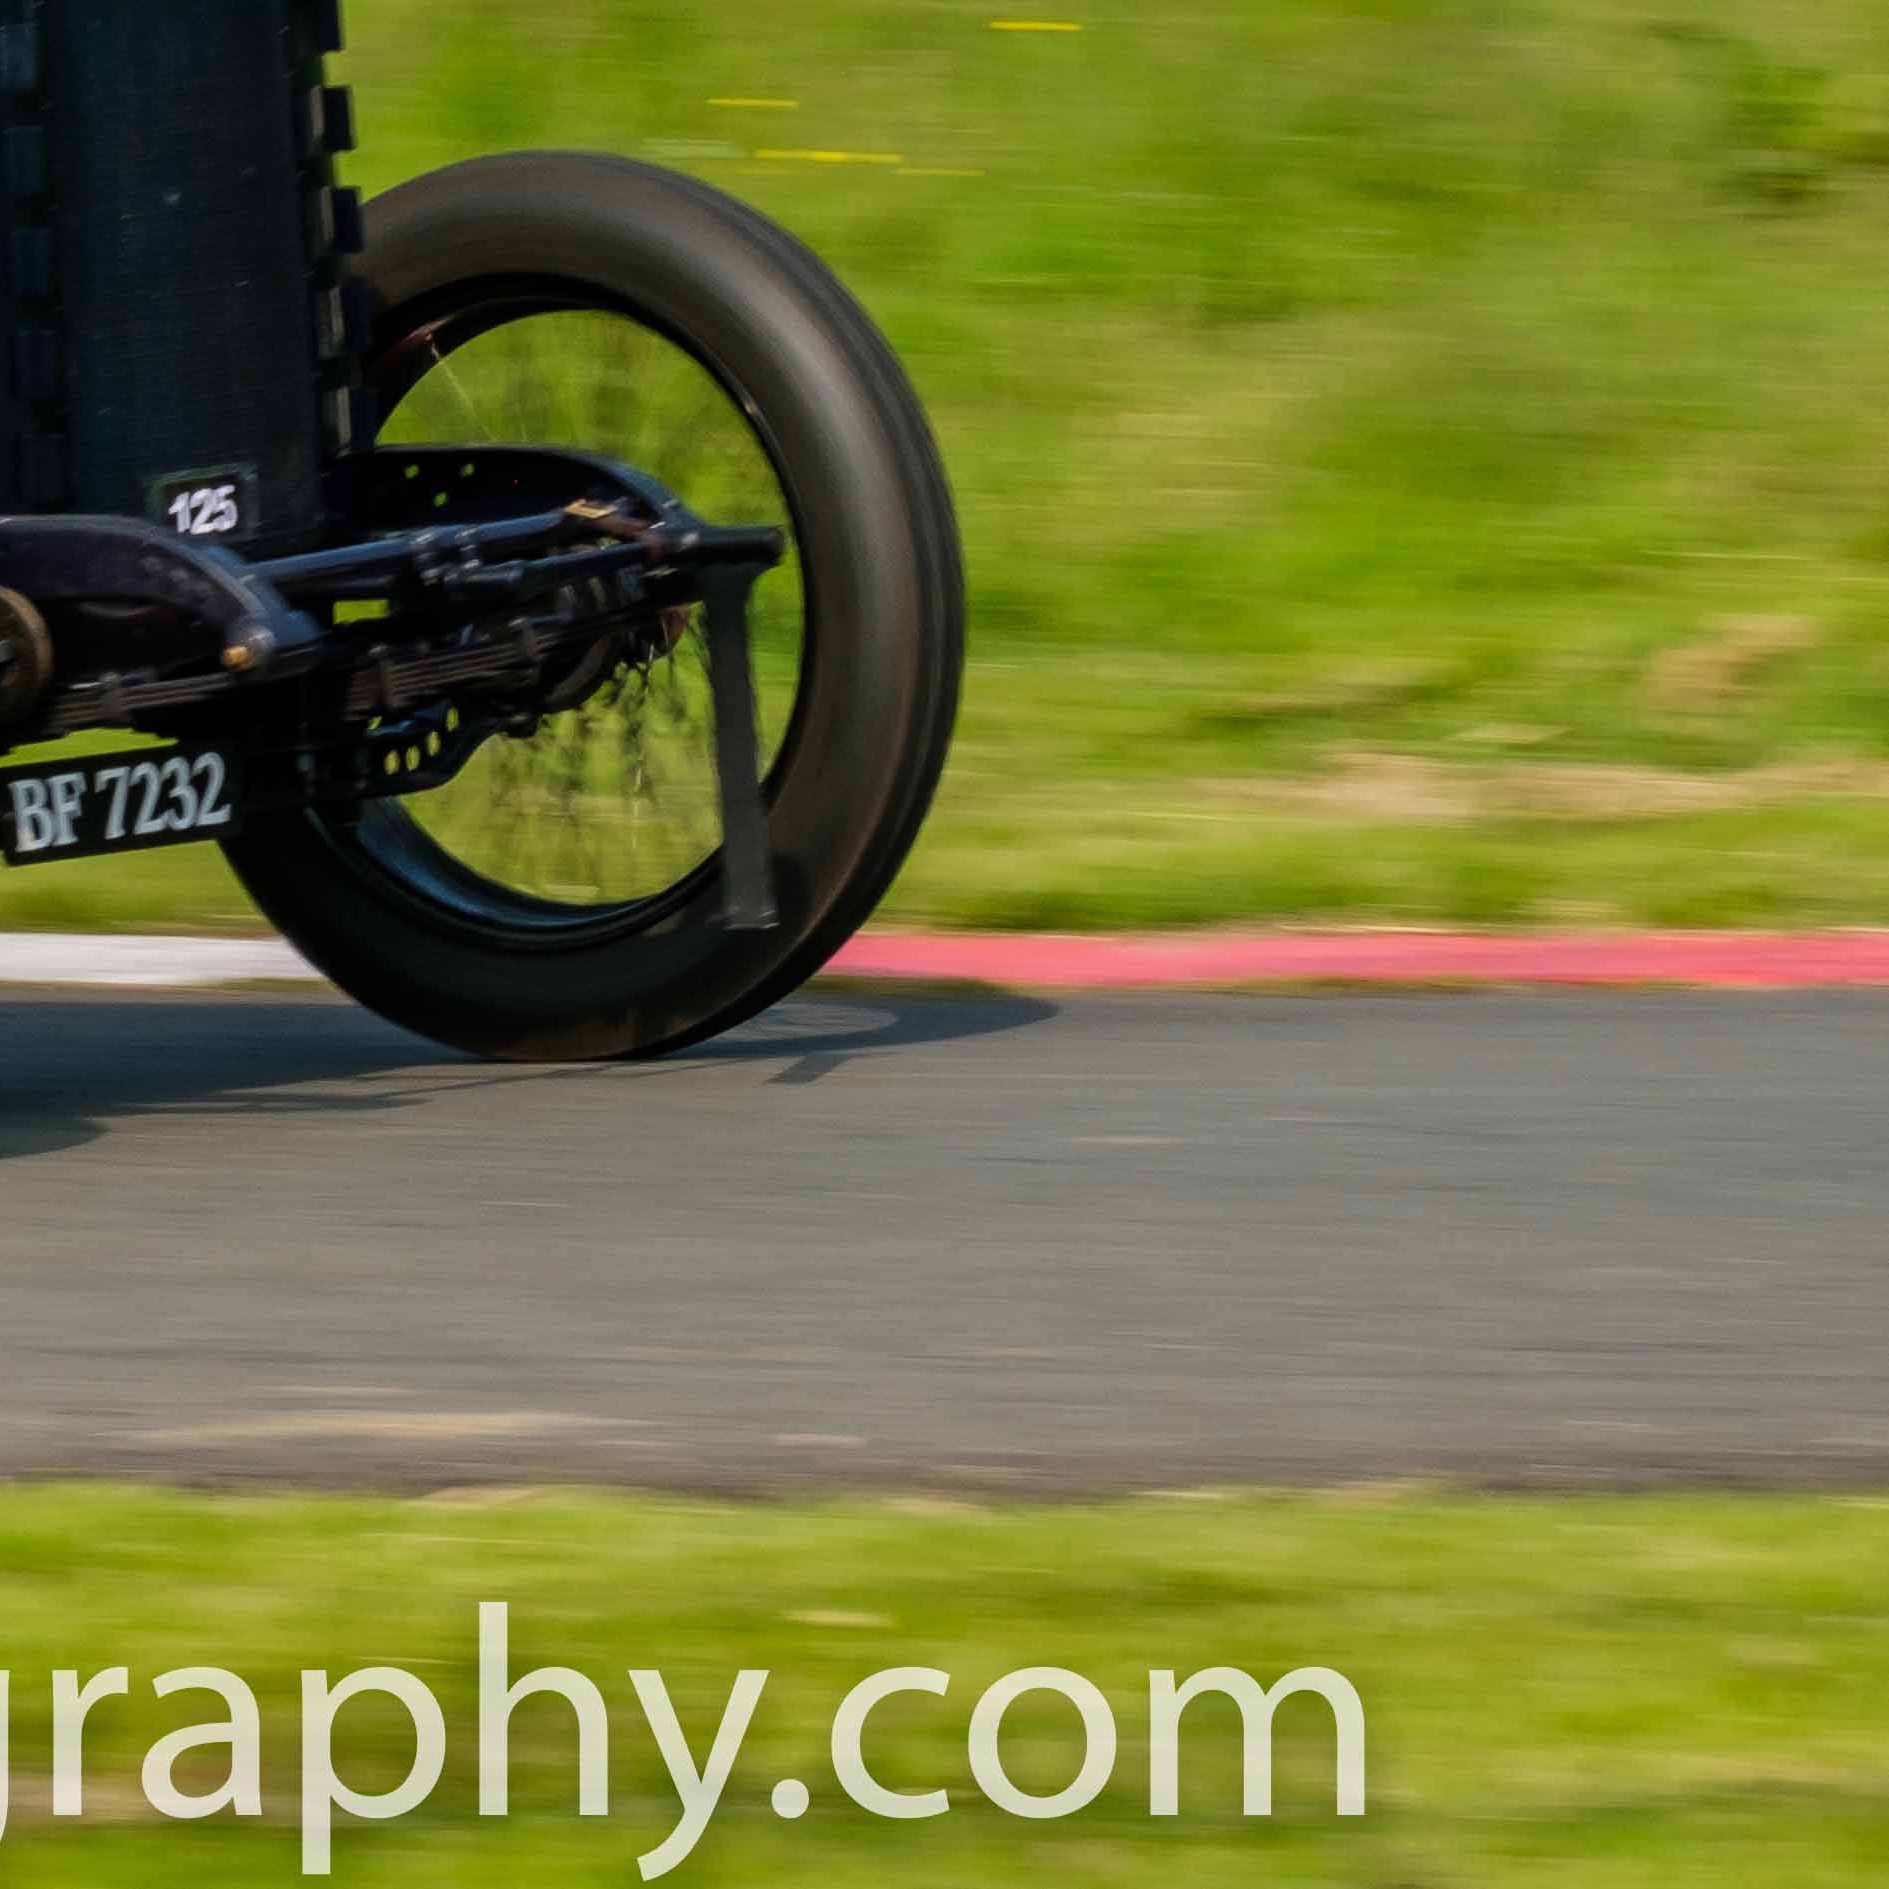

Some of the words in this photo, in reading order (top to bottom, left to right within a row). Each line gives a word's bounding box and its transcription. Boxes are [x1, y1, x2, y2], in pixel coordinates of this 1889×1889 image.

[168, 484, 238, 536] 125
[8, 772, 87, 853] BF
[95, 752, 231, 841] 7232
